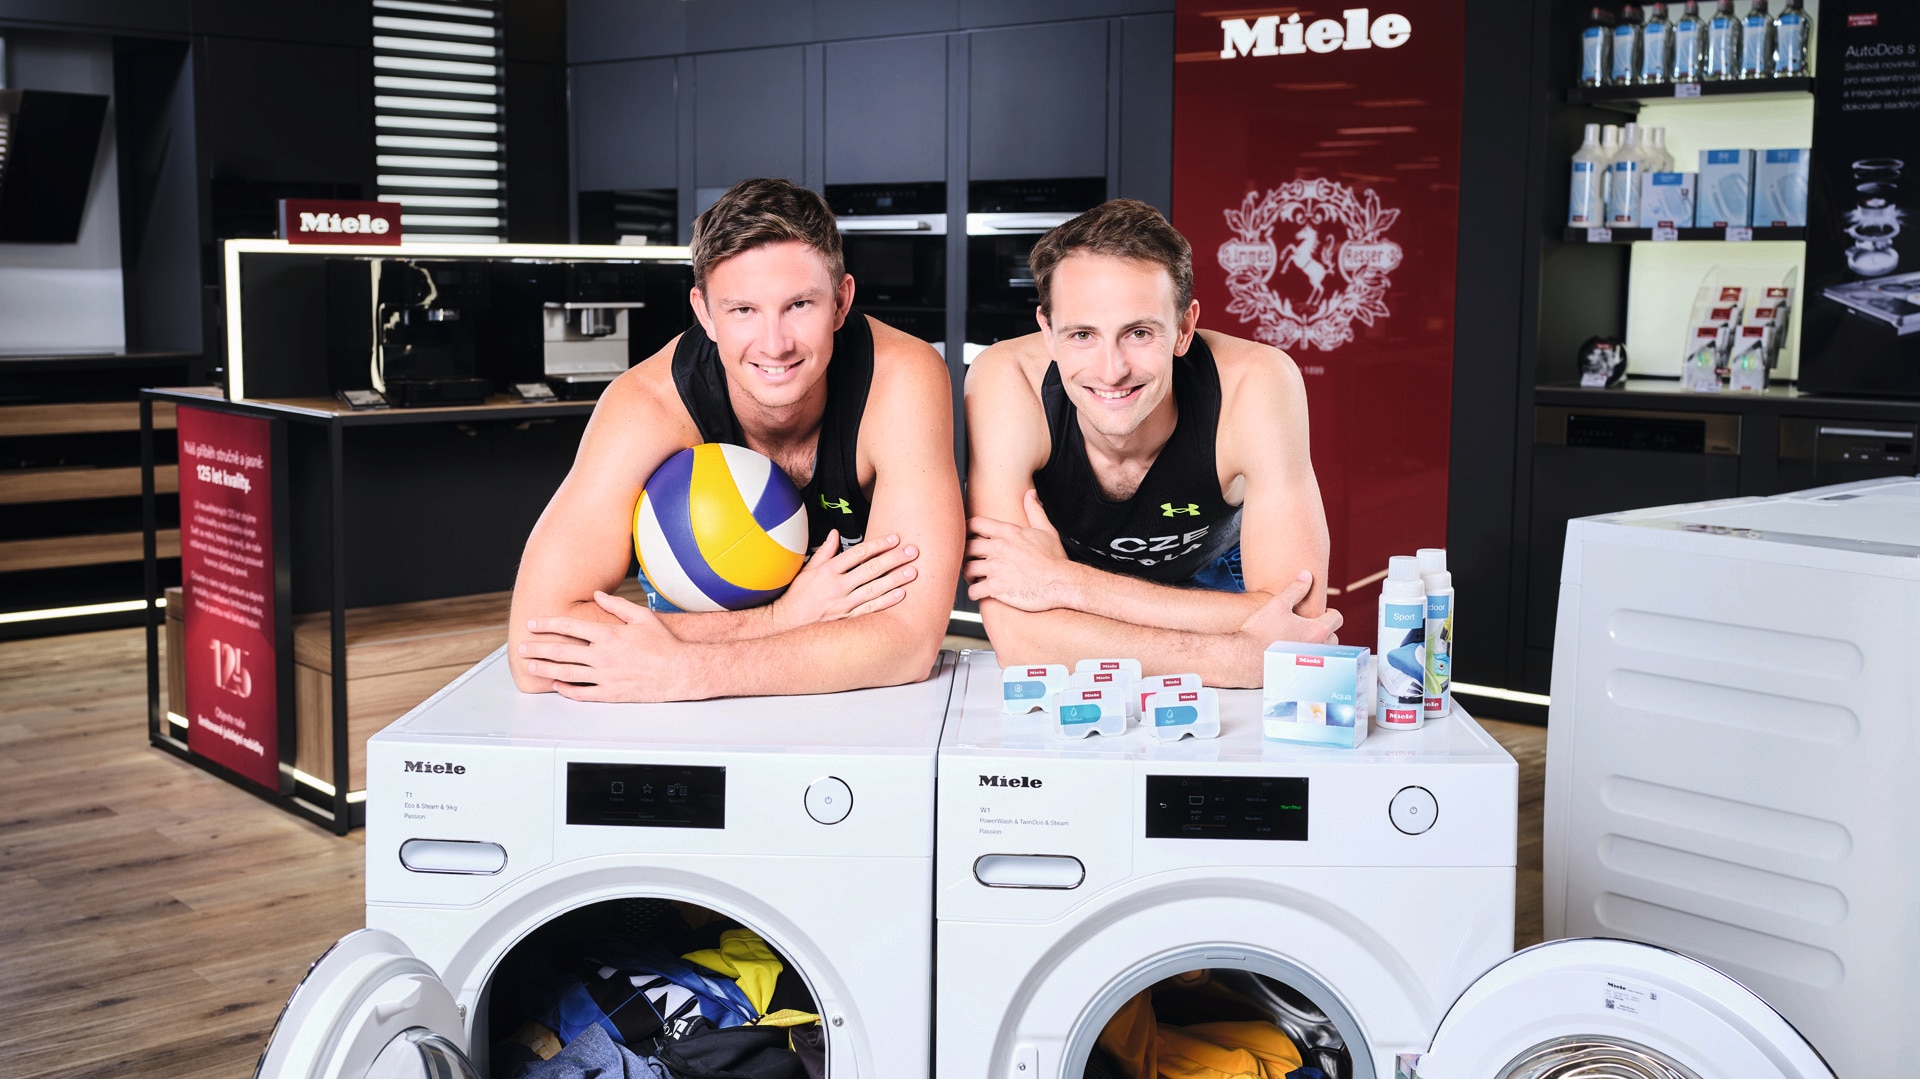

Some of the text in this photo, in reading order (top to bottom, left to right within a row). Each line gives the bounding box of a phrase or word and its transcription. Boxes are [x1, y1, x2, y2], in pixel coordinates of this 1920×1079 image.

[1220, 8, 1412, 59] Miele
[1845, 43, 1916, 57] AutoDos s
[299, 212, 390, 235] Miele
[196, 464, 251, 494] 125 let kvality.
[1110, 525, 1209, 553] CZE
[1427, 603, 1446, 611] door
[1393, 612, 1415, 621] Sport
[1298, 656, 1321, 664] Miele
[209, 639, 252, 698] 125
[1331, 691, 1352, 701] Aqua
[1389, 712, 1414, 720] Miele
[404, 760, 467, 775] Miele
[979, 774, 1042, 788] Miele
[404, 812, 426, 820] Passion
[979, 817, 1013, 825] PowerWash
